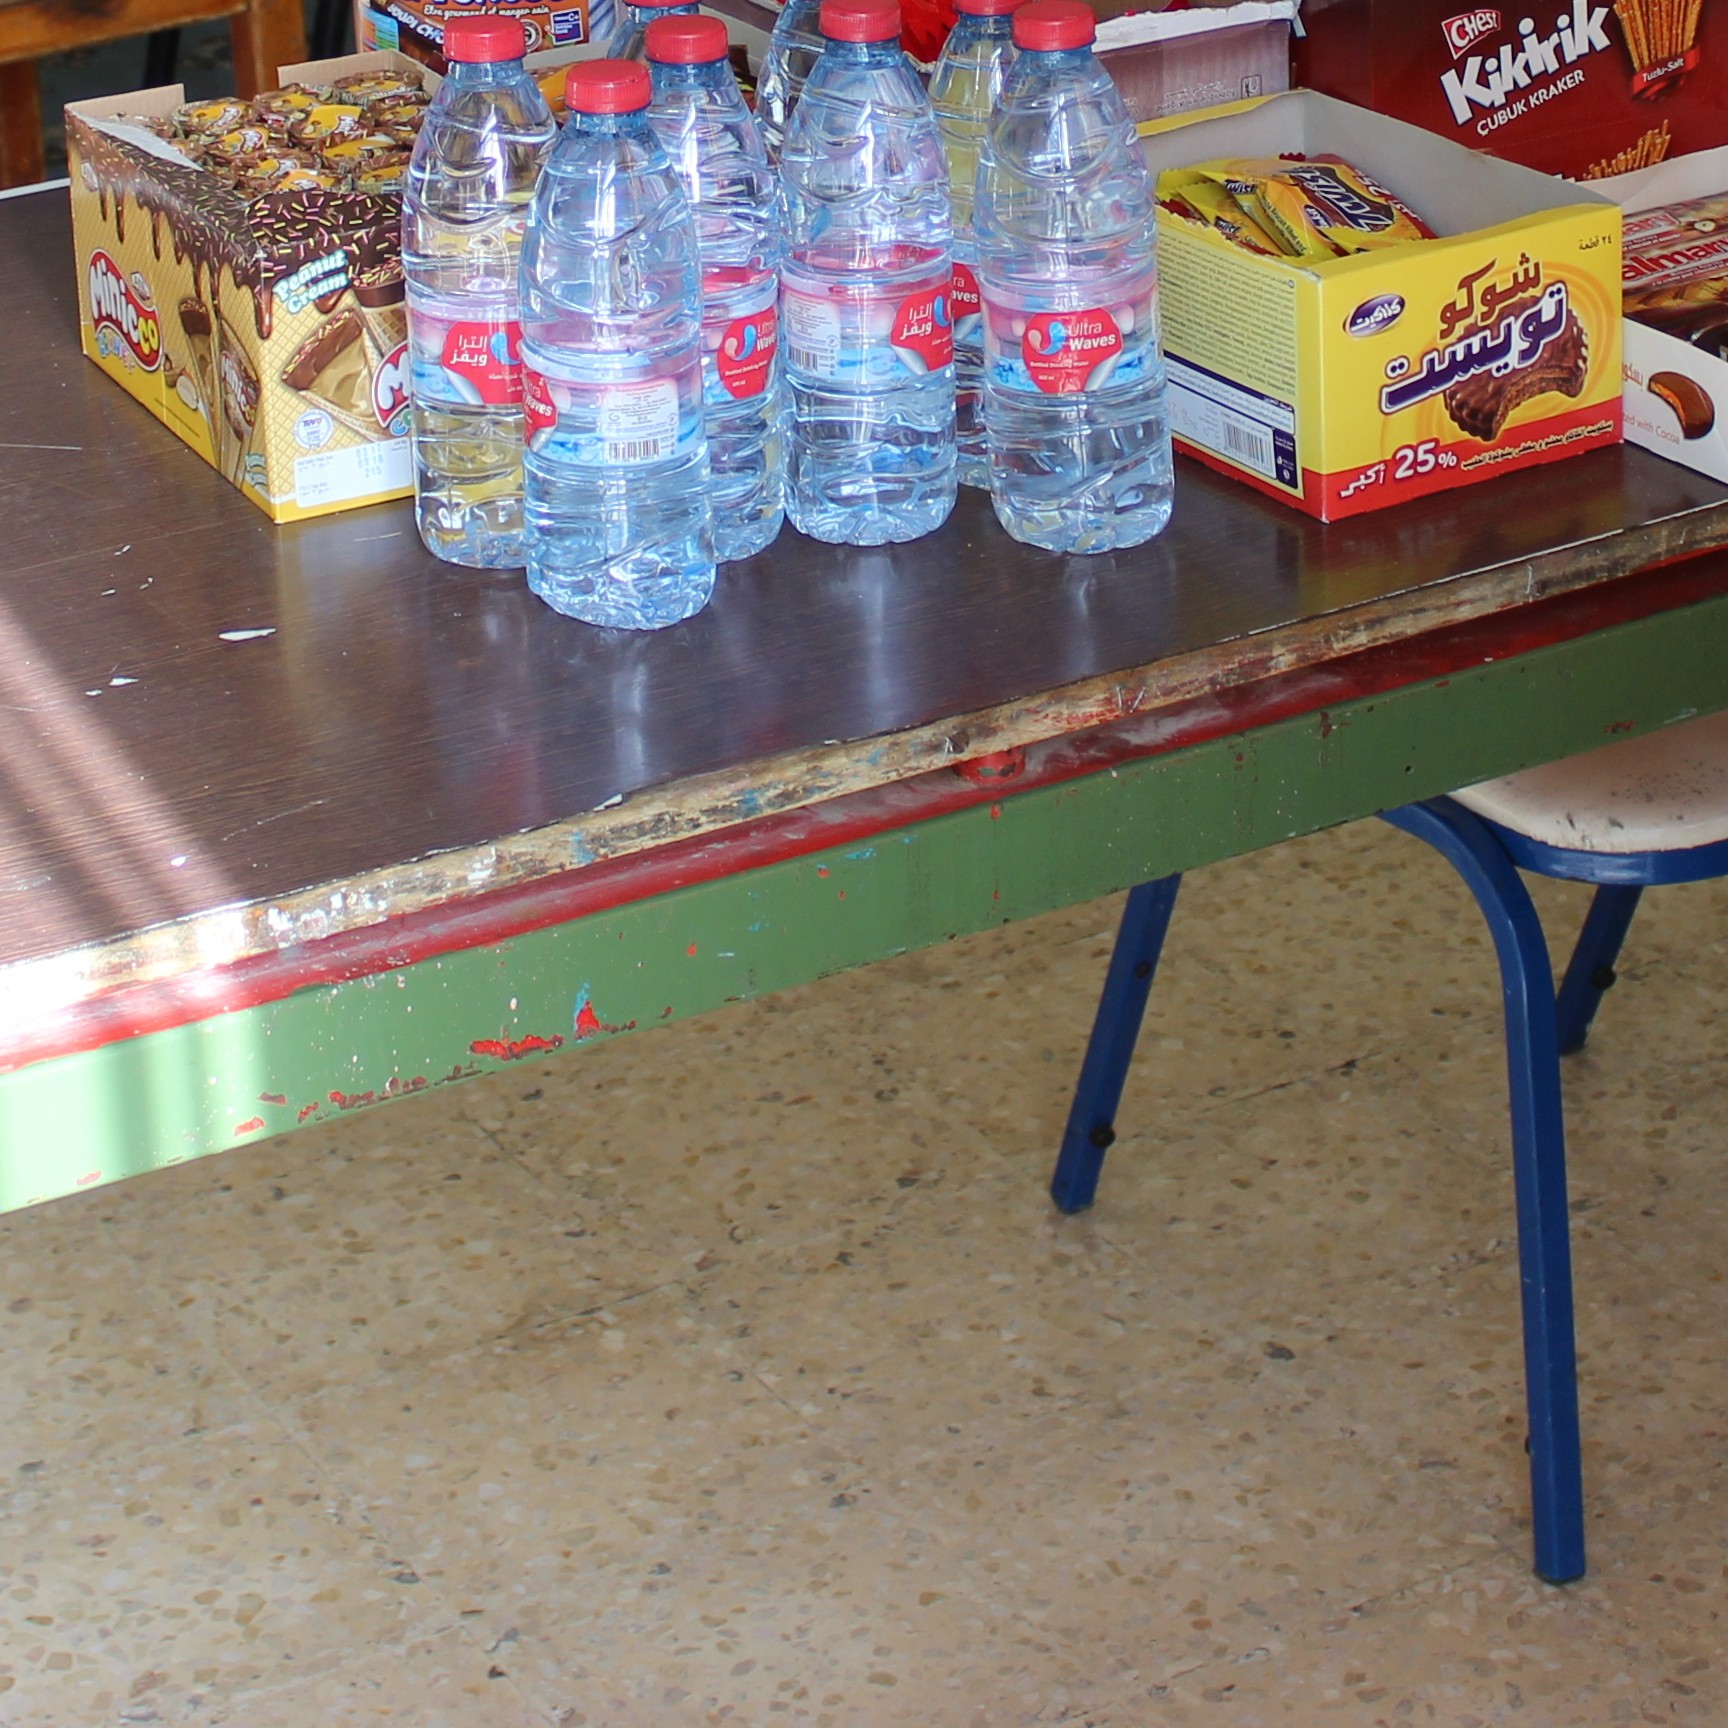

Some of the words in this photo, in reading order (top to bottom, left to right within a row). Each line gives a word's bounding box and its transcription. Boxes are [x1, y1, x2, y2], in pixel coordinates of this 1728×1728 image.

[1642, 58, 1684, 82] Tuzlu-Salt
[1476, 101, 1527, 137] ÇUBUK
[1529, 69, 1585, 107] KRAKER
[274, 250, 348, 302] Peanut
[286, 273, 348, 315] Cream
[952, 292, 979, 305] aves
[1439, 252, 1542, 340] شوكو
[1069, 321, 1102, 339] Ultra
[1069, 335, 1116, 352] Waves
[1383, 282, 1566, 412] تويست
[1637, 418, 1654, 432] with
[1656, 425, 1680, 445] Cocoa
[1340, 465, 1386, 497] أكبر
